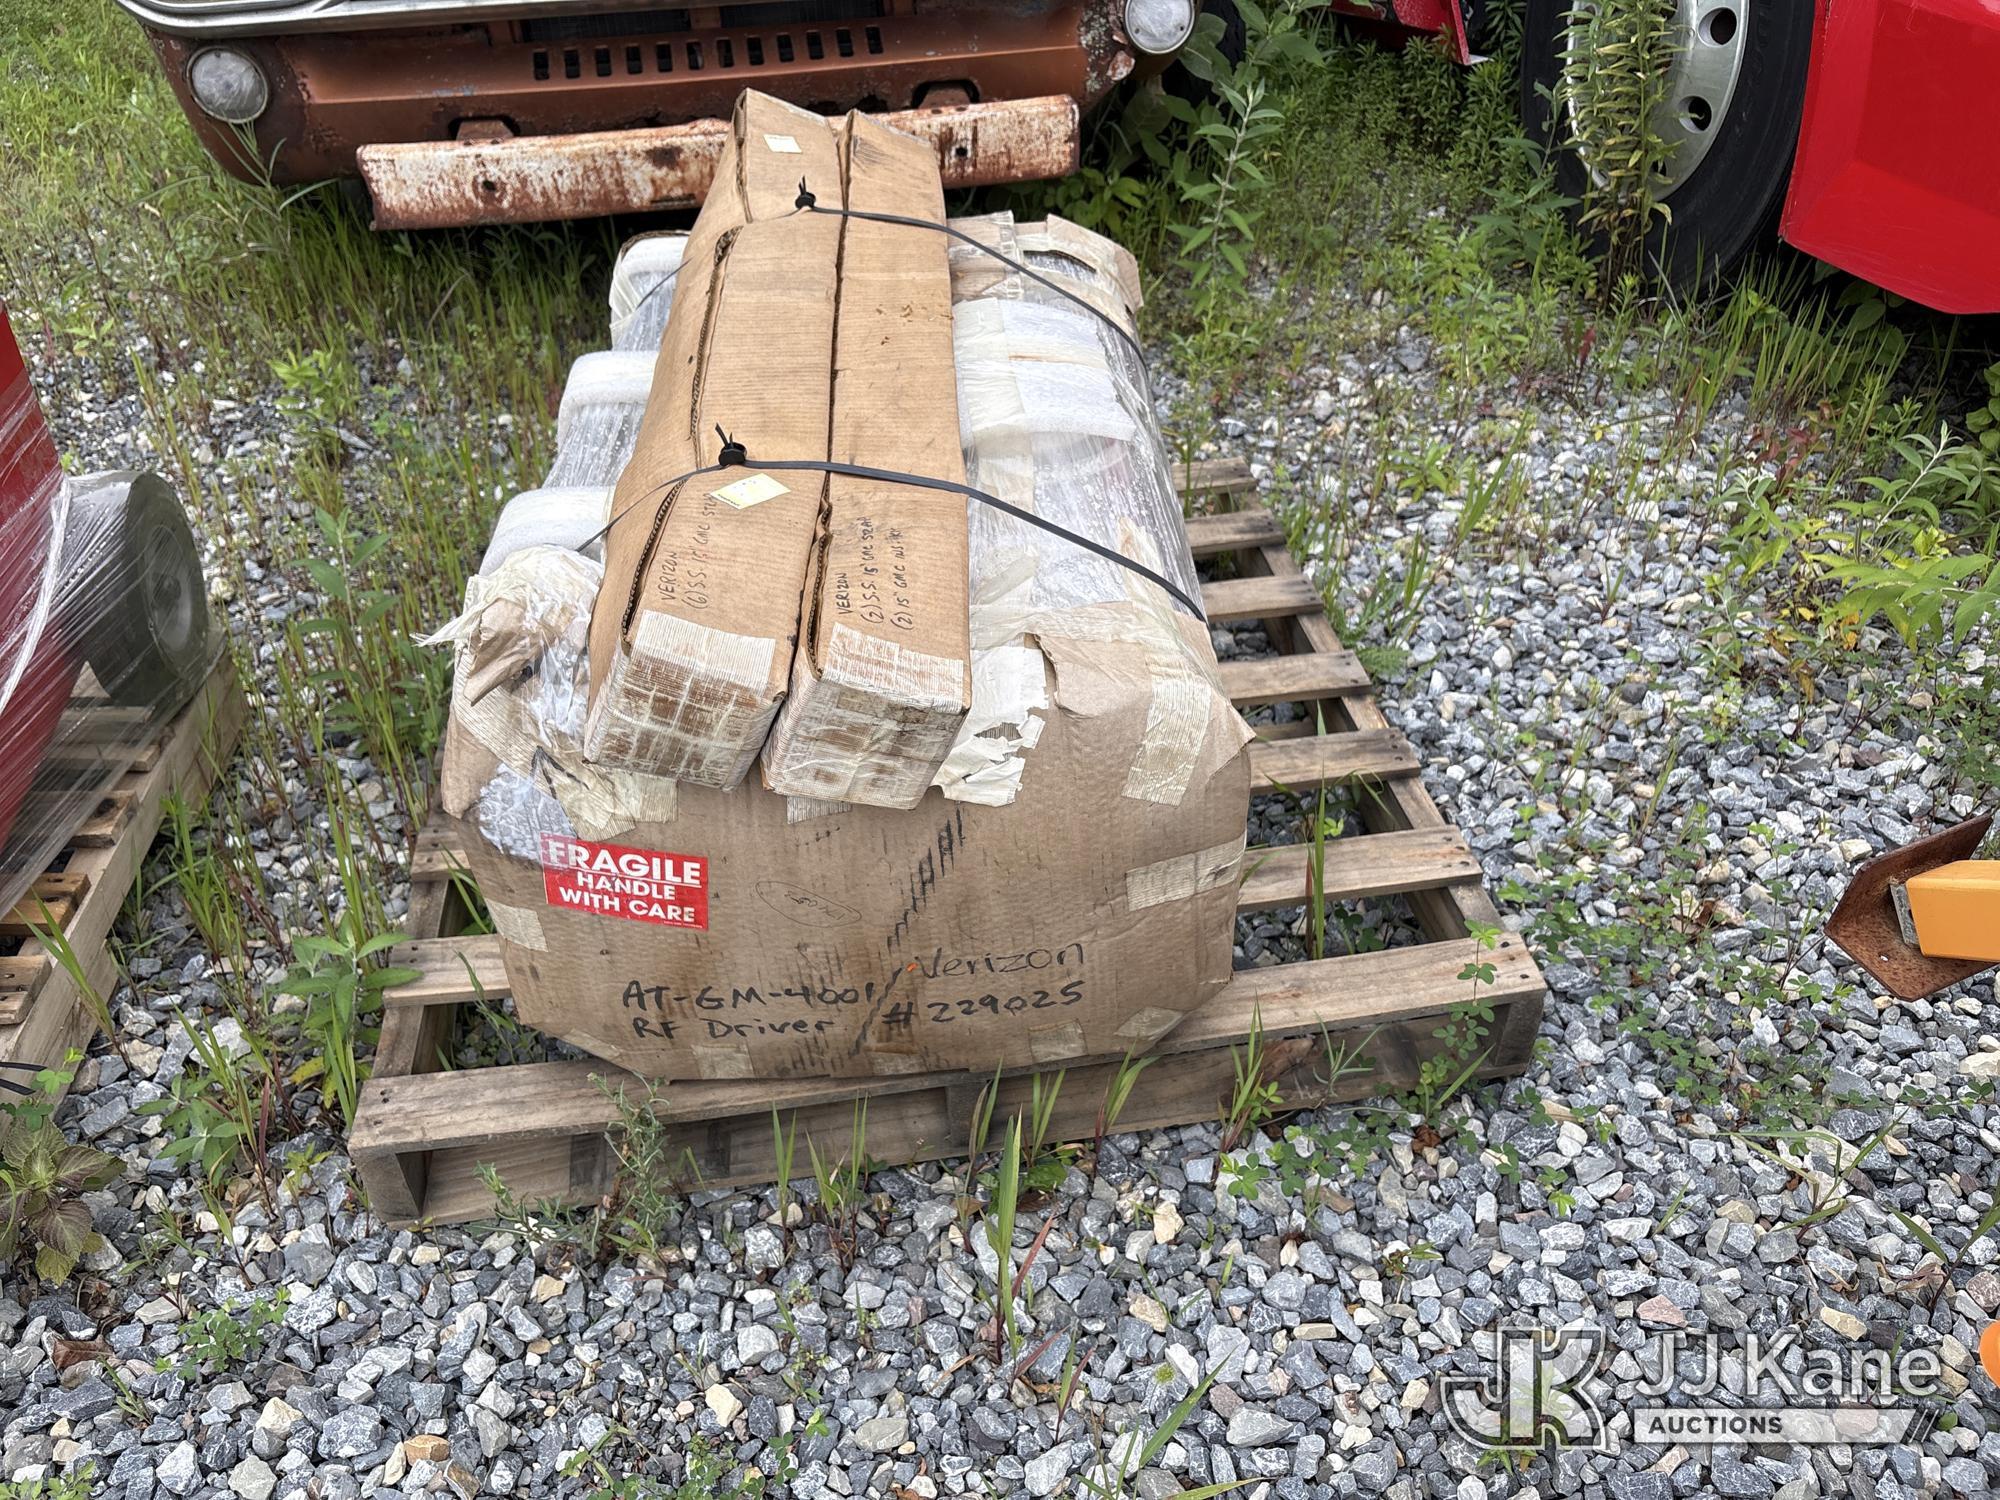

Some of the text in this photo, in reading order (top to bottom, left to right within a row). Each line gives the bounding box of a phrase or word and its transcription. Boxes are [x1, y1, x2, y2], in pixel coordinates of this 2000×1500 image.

[658, 552, 677, 601] VERIZON
[835, 572, 853, 615] VERIZON
[893, 565, 907, 589] GMC
[547, 839, 701, 885] FRAGILE
[577, 871, 676, 900] HANDLE
[559, 887, 695, 922] WITH CARE
[915, 943, 1084, 978] Verizon
[632, 1016, 835, 1039] RF Driver
